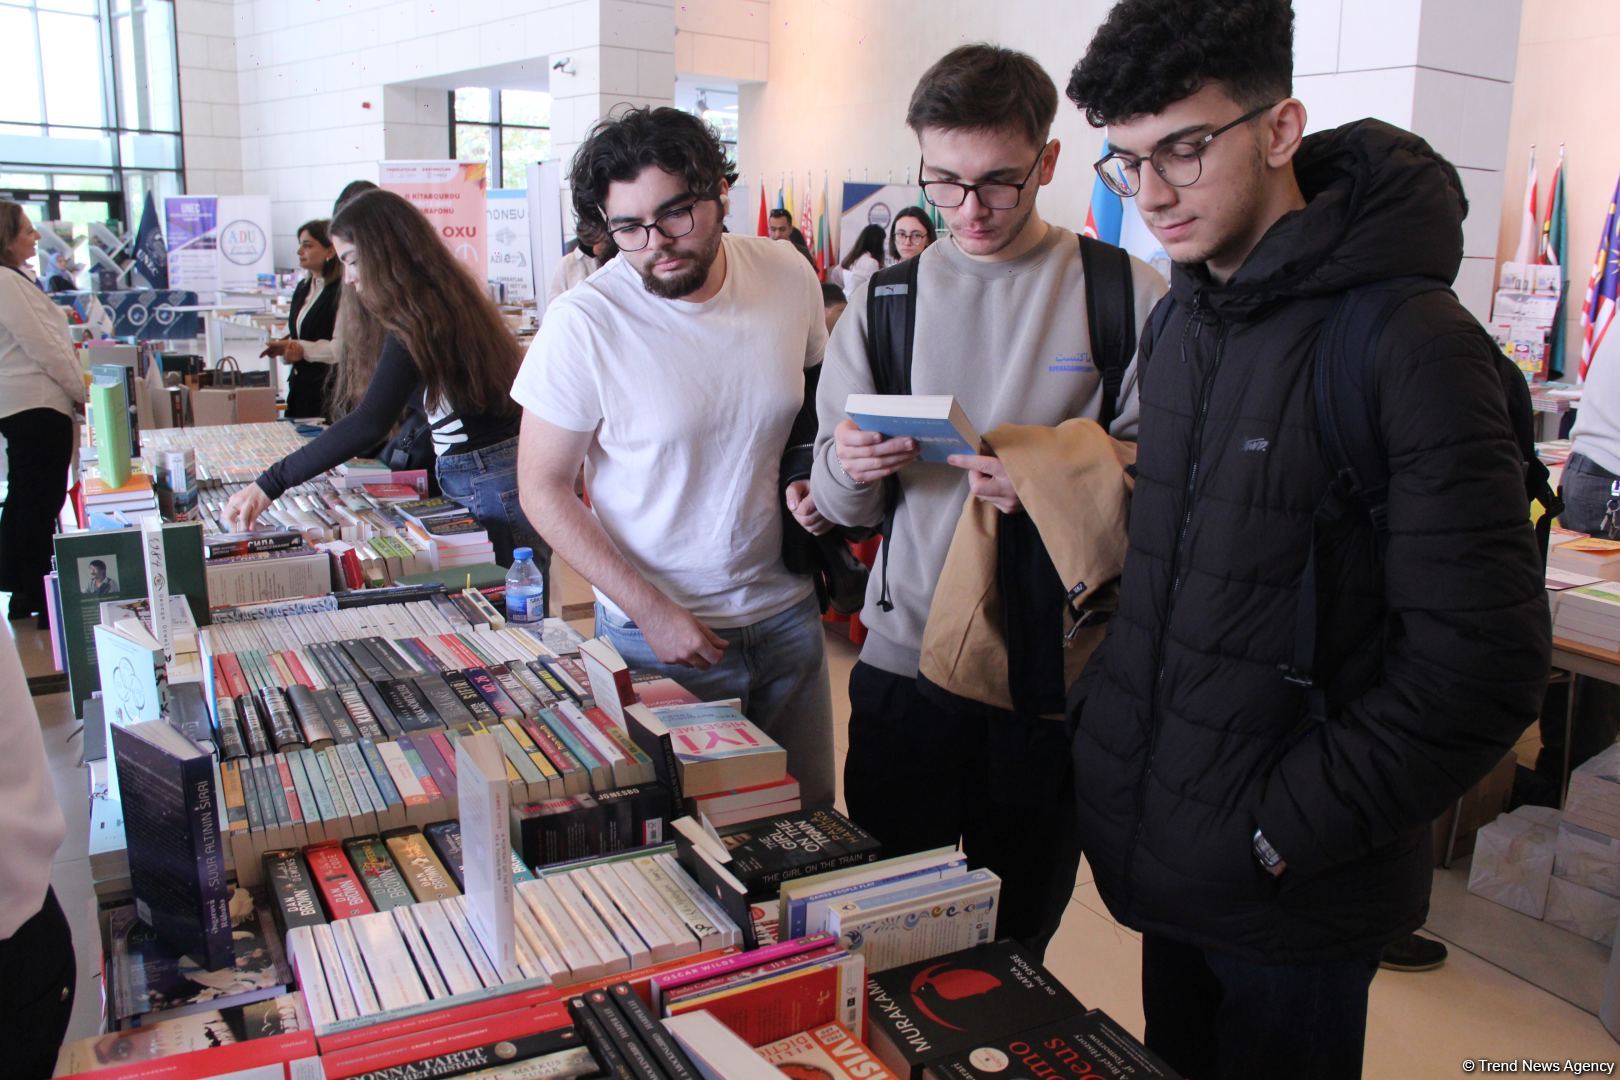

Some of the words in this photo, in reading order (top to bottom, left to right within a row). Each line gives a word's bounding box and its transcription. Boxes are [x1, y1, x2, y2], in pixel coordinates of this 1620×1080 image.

[228, 230, 256, 243] ADU
[442, 226, 476, 237] OXU
[136, 249, 159, 276] UNEC
[677, 728, 759, 755] İYİ
[775, 817, 801, 838] THE
[795, 817, 831, 847] TRAIN
[811, 815, 841, 841] PAULA
[815, 809, 859, 844] HAWKINS
[759, 834, 778, 850] THE
[769, 828, 797, 853] GIRL
[797, 834, 820, 854] ON
[417, 871, 431, 887] DAN
[426, 865, 447, 889] BROWN
[763, 873, 780, 883] THE
[782, 869, 800, 878] GIRL
[821, 859, 835, 869] THE
[839, 855, 862, 864] TRAIN
[340, 880, 363, 905] BROWN
[369, 877, 386, 894] DAN
[379, 868, 405, 897] BROWN
[833, 888, 857, 896] PEOPLE
[859, 883, 876, 891] PLAY
[284, 897, 298, 912] DAN
[295, 890, 315, 915] BROWN
[330, 888, 345, 902] DAN
[663, 971, 699, 981] OSCAR
[702, 959, 735, 972] WILDE
[1010, 952, 1035, 977] SHORE
[1010, 966, 1034, 990] KAFKA
[1034, 975, 1046, 986] THE
[1045, 985, 1056, 996] ON
[604, 1006, 615, 1018] LEE
[627, 999, 639, 1010] LEE
[868, 976, 931, 1053] MURAKAMI
[449, 1029, 488, 1042] PUNISHMENT
[1073, 1032, 1100, 1058] History
[420, 1048, 483, 1071] TARTT
[652, 1032, 684, 1072] MOCKINGBIRD
[1088, 1033, 1123, 1066] Tomorrow
[432, 1057, 488, 1075] HISTORY
[513, 1059, 560, 1076] MARKUS
[1098, 1058, 1120, 1075] Brief
[1122, 1065, 1135, 1075] of
